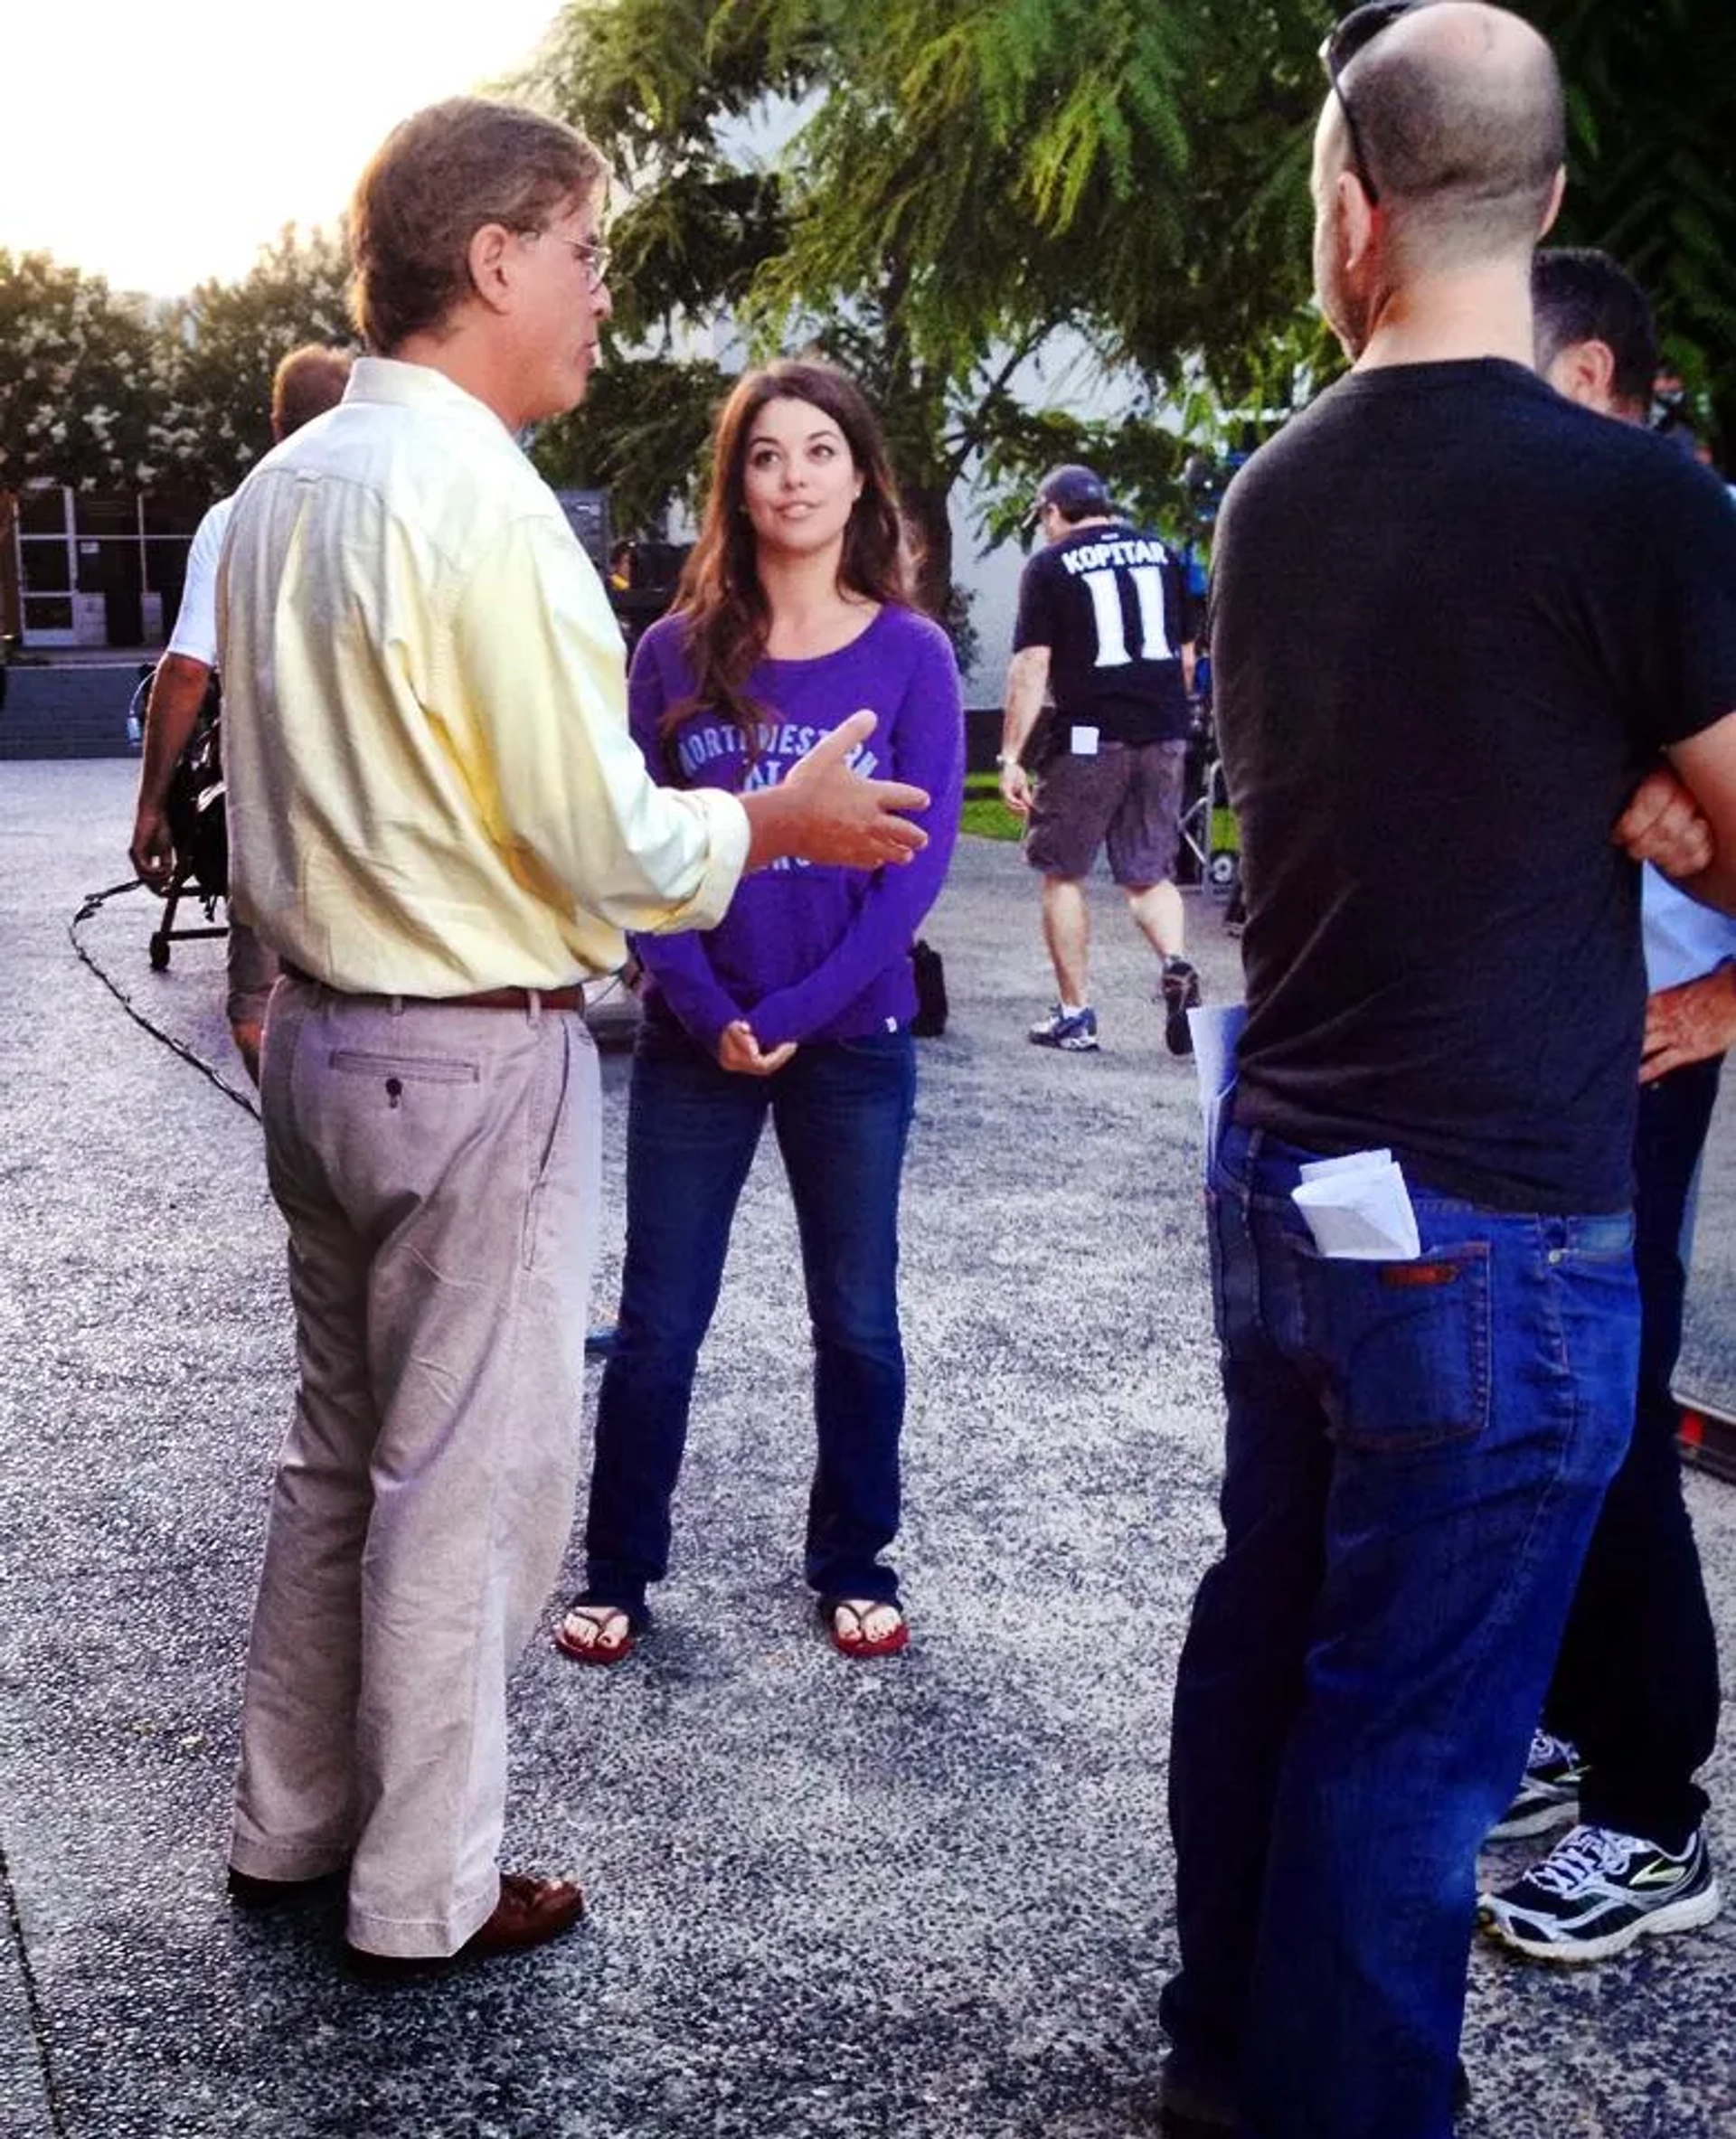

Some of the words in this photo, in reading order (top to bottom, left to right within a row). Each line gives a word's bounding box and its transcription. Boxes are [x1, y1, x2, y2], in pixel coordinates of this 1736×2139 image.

[1061, 540, 1169, 576] KOPITAR
[1080, 566, 1174, 667] 11
[678, 723, 878, 778] NORTWESRN
